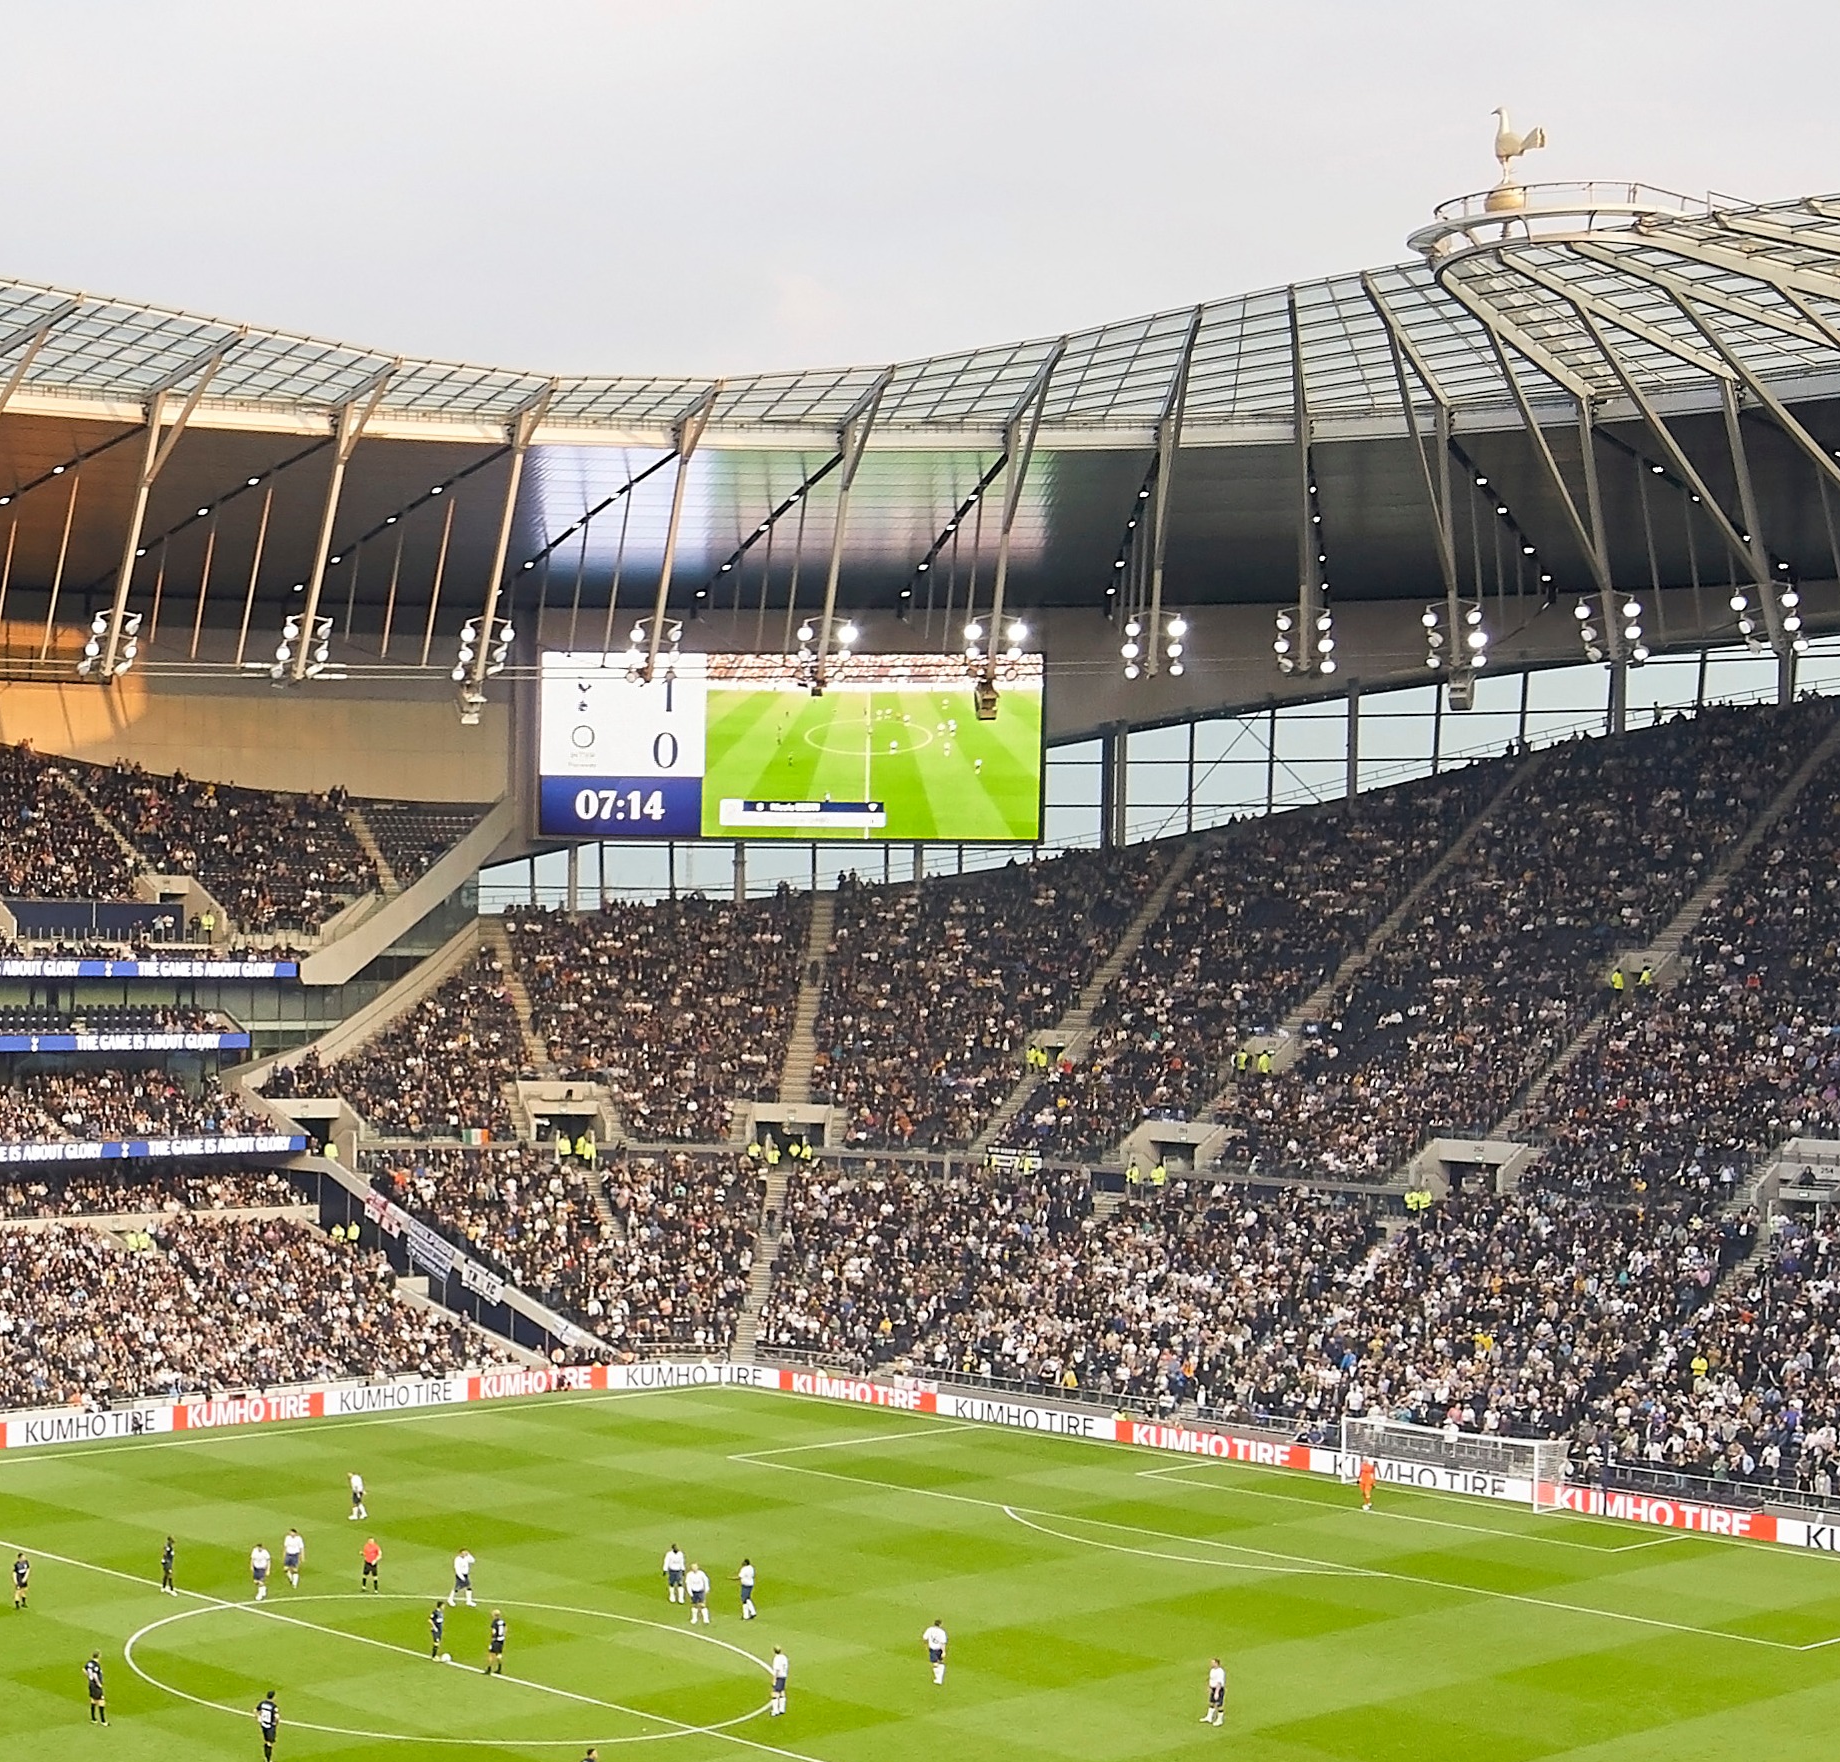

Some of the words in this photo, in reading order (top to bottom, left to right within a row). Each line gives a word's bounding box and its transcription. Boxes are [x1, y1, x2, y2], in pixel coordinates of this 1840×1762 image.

[652, 732, 678, 768] 0
[575, 788, 665, 822] 07:14
[480, 1370, 550, 1399] KUMHO
[626, 1365, 707, 1387] KUMHO
[792, 1373, 872, 1404] KUMHO
[187, 1399, 265, 1429] KUMHO
[268, 1394, 311, 1421] TIRE
[340, 1386, 410, 1412] KUMHO
[415, 1382, 452, 1404] TIRE
[26, 1415, 107, 1443] KUMHO
[955, 1398, 1039, 1430] KUMHO
[1132, 1422, 1230, 1457] KUMHO
[1556, 1487, 1675, 1527] KUMHO
